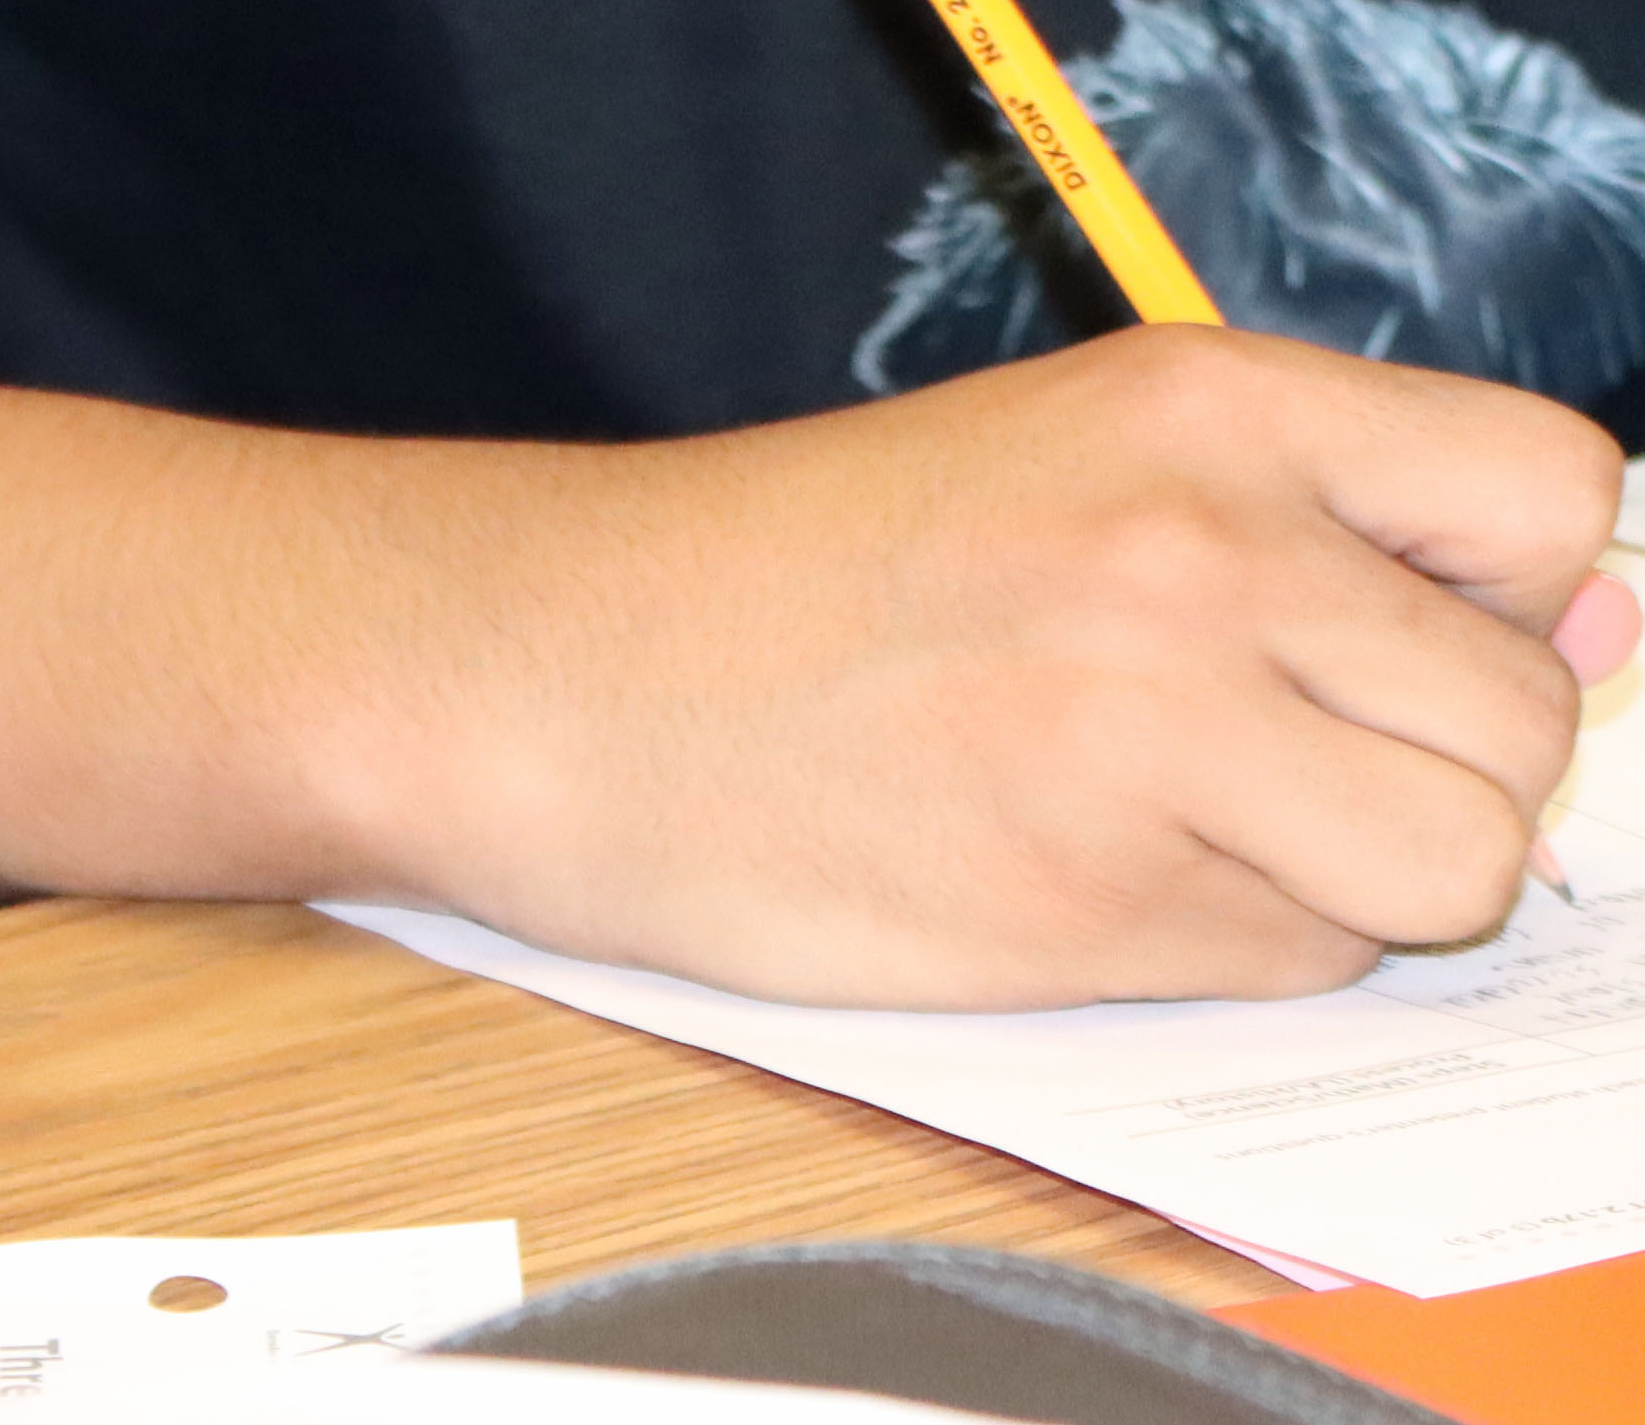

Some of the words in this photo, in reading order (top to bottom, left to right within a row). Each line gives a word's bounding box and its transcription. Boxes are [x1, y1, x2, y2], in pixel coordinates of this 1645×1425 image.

[970, 16, 1002, 66] No.
[1017, 102, 1087, 192] DIXON
[1493, 1090, 1593, 1111] student
